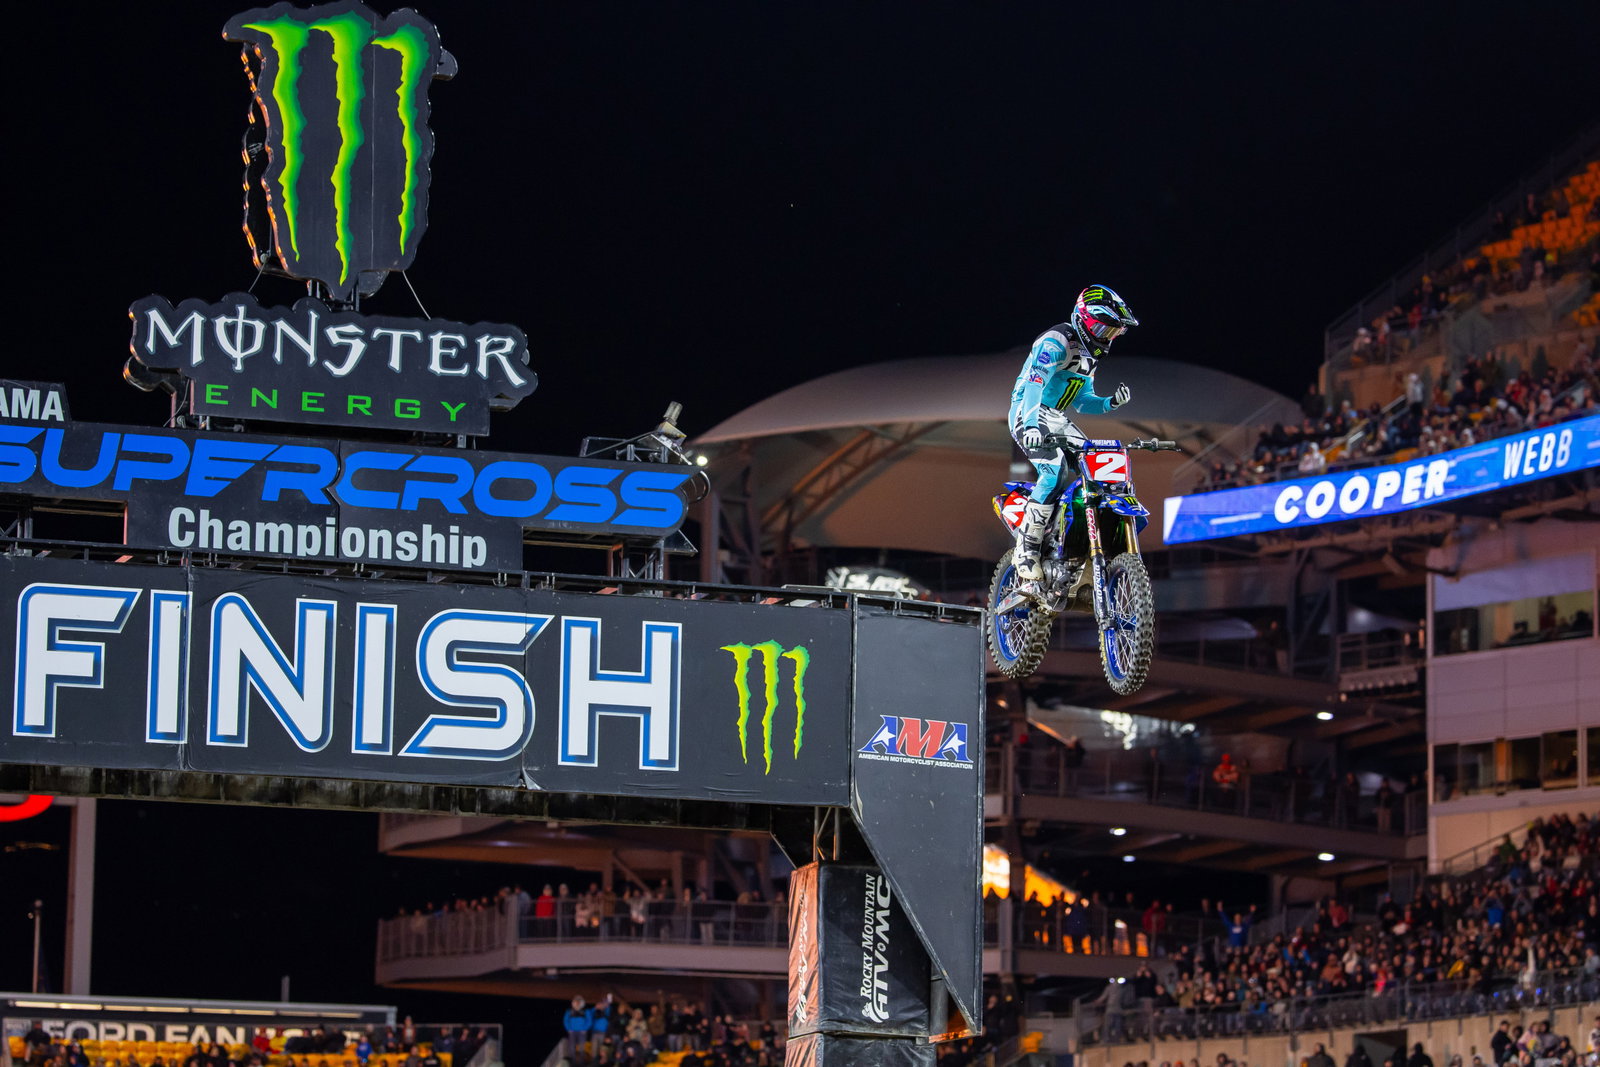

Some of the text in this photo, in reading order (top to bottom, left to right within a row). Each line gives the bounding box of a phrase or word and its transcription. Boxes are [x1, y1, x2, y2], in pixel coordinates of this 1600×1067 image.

[205, 384, 467, 422] ENERGY
[0, 424, 697, 528] SUPERCROSS
[1094, 453, 1126, 482] 2
[1274, 429, 1573, 523] COOPER WEBB
[168, 507, 487, 568] Championship
[13, 582, 682, 772] FINISH
[857, 714, 974, 763] AMA
[858, 753, 973, 770] AMERICAN MOTORCYCLIST ASSOCIATION
[861, 874, 876, 1000] ROCKY MOUNTAIN
[165, 1024, 245, 1045] FAN
